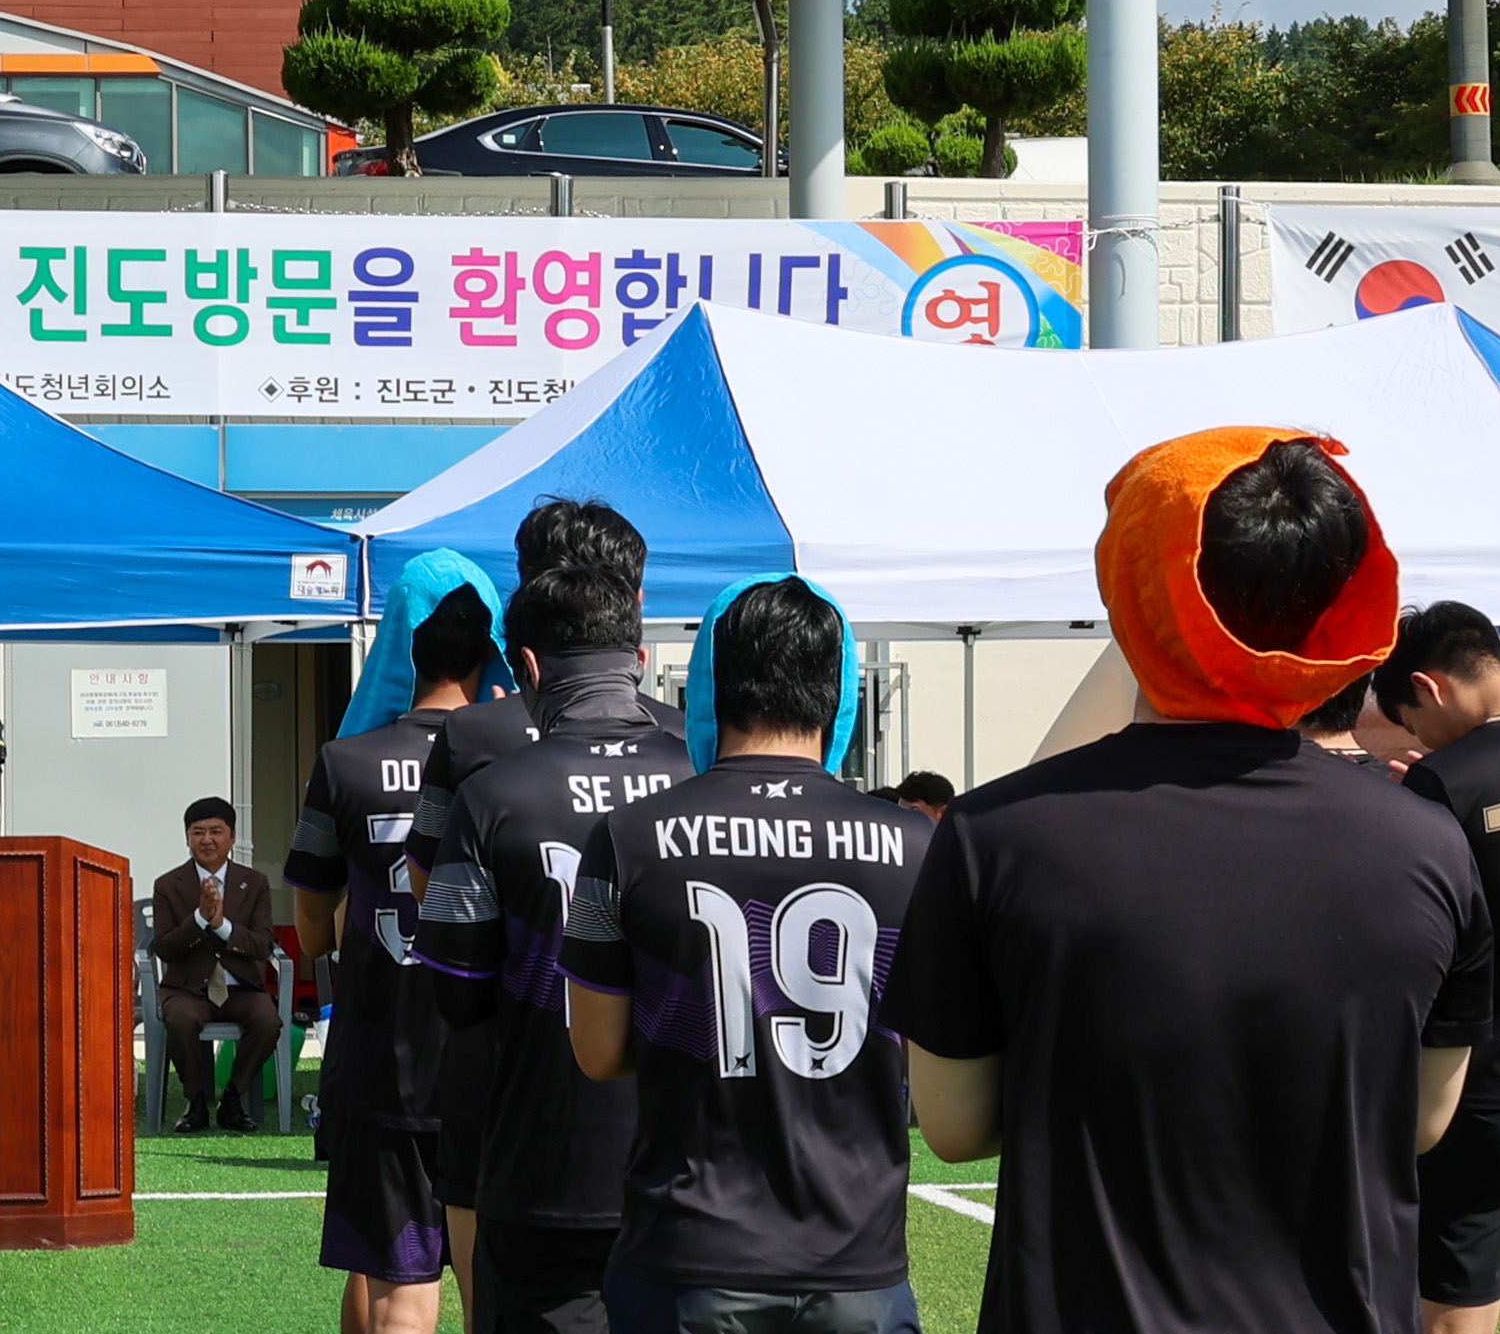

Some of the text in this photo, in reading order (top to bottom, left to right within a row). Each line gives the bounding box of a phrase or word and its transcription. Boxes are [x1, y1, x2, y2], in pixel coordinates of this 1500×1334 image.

[17, 245, 420, 348] 진도방문을
[3, 373, 172, 401] 도청년회의소
[286, 376, 340, 404] 후원
[376, 378, 457, 404] 진도군
[488, 378, 577, 405] 진도청
[568, 774, 615, 814] SE
[655, 815, 906, 867] KYEONG HUN
[686, 881, 879, 1079] 19
